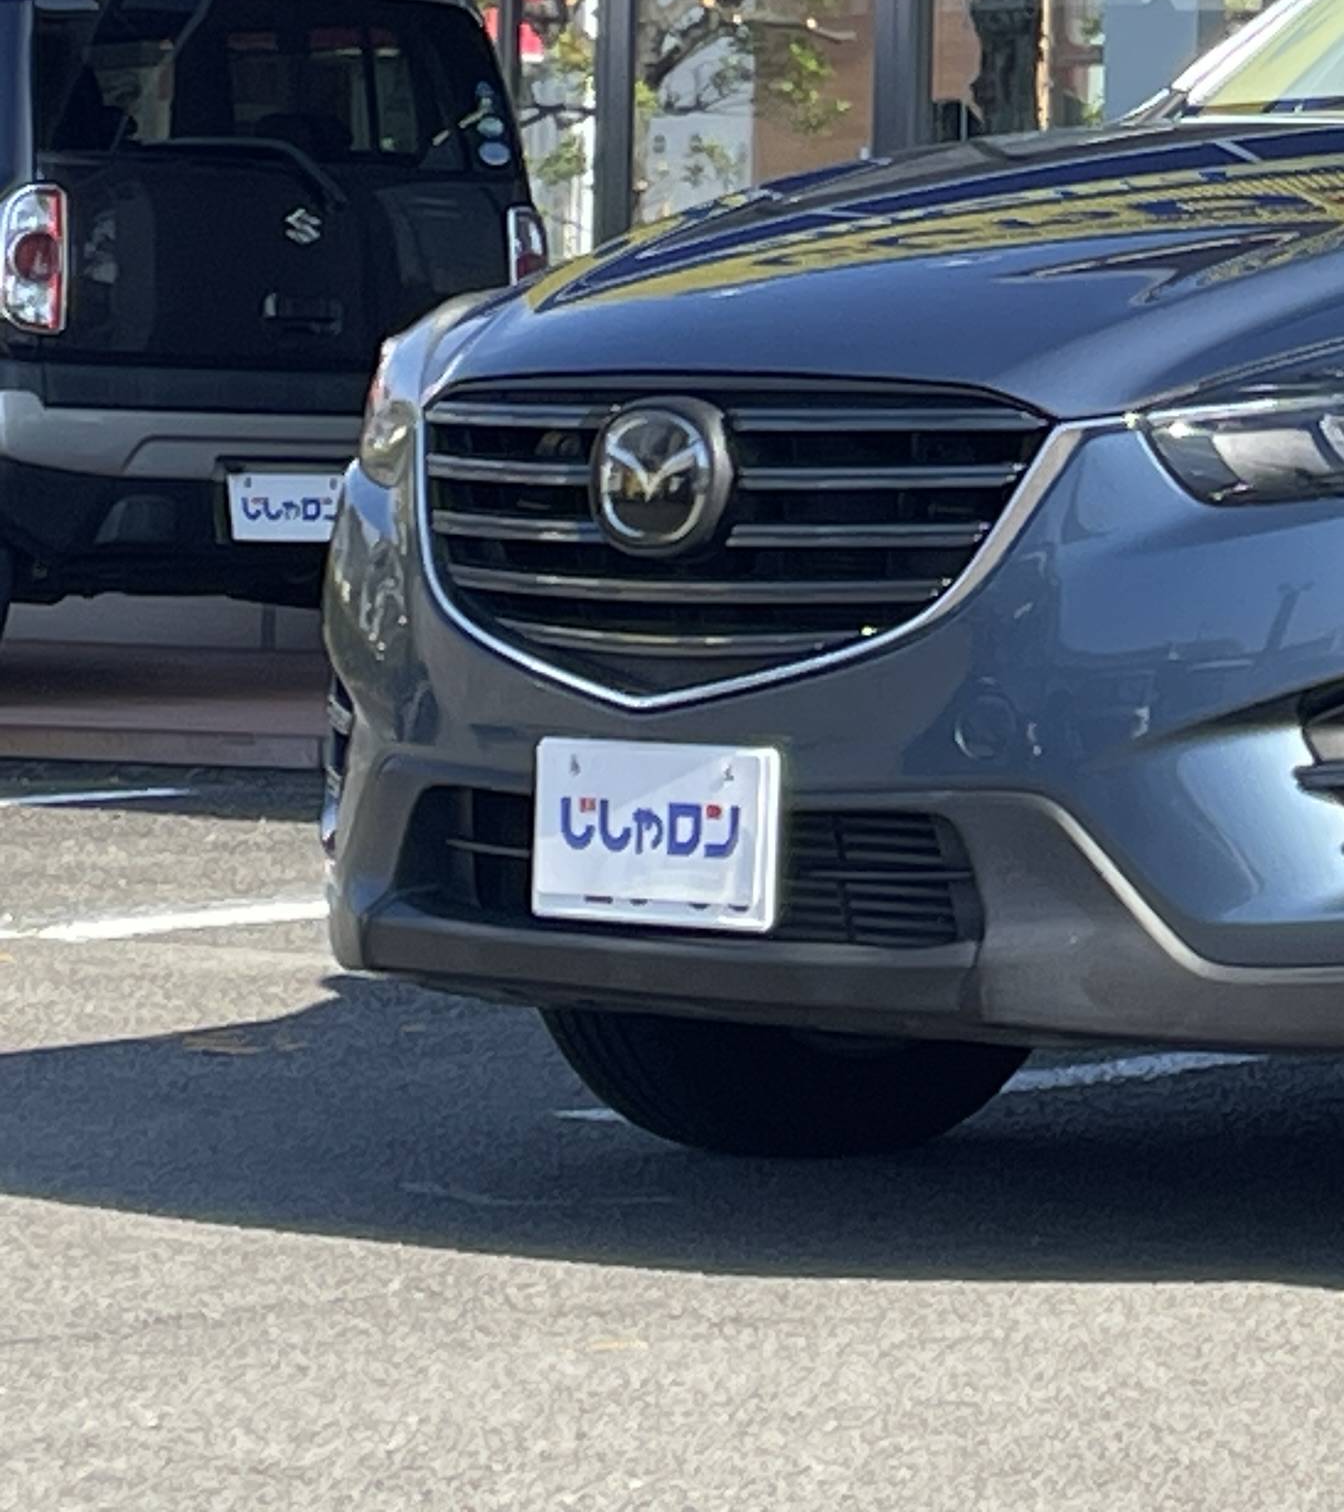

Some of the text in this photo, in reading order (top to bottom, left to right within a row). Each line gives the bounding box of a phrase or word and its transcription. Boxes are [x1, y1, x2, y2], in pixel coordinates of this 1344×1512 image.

[560, 796, 740, 859] じしゃロン
